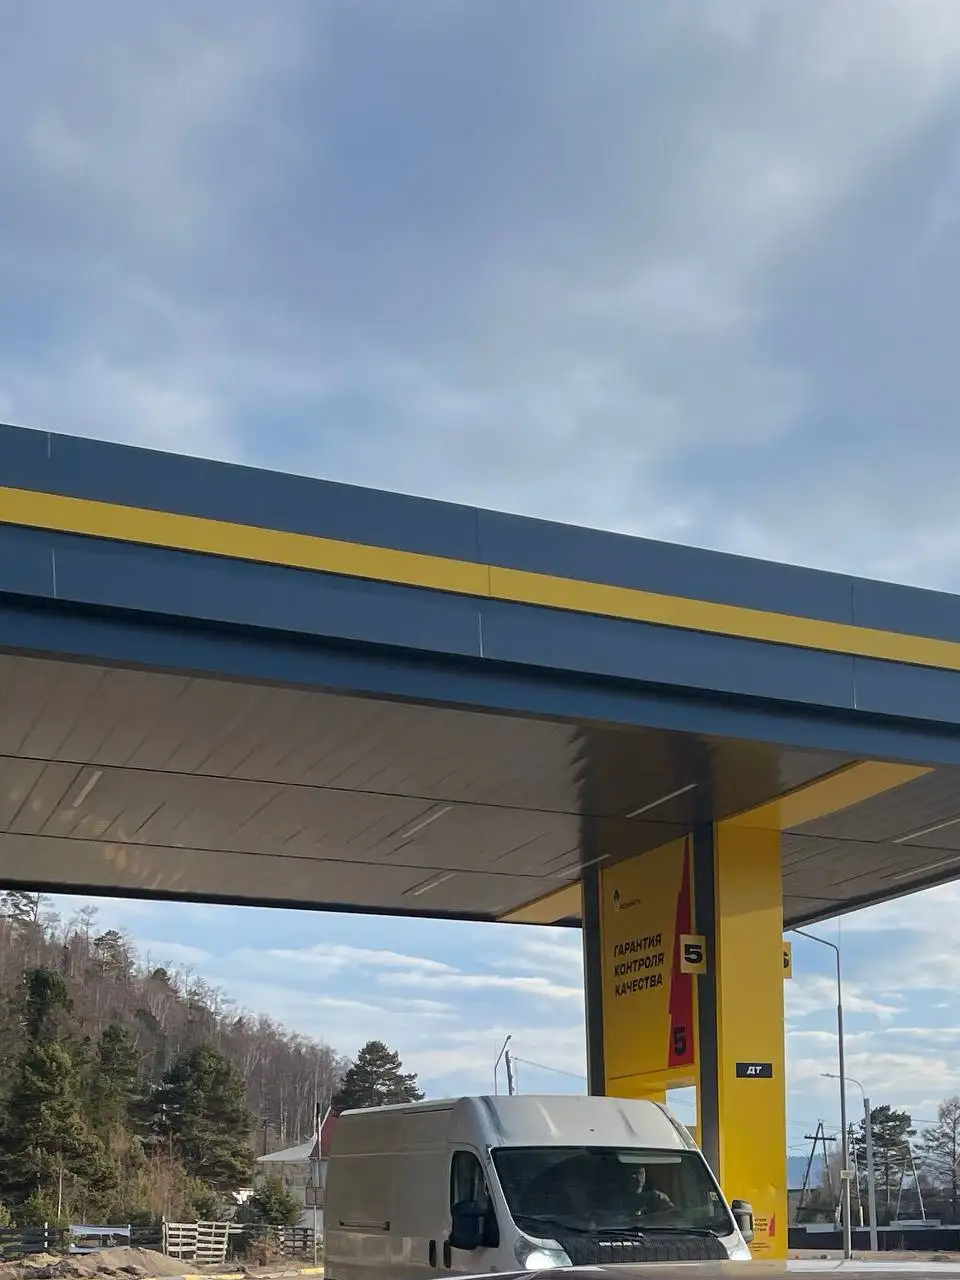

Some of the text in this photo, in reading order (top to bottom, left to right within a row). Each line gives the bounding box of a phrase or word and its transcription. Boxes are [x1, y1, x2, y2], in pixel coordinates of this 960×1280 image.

[613, 933, 662, 958] ГАРАНТИЯ
[684, 943, 703, 964] 5
[613, 953, 665, 977] КОНТРОЛЯ
[614, 973, 664, 997] КАЧЕСТВА
[673, 1026, 687, 1056] 5
[746, 1066, 762, 1075] ДТ
